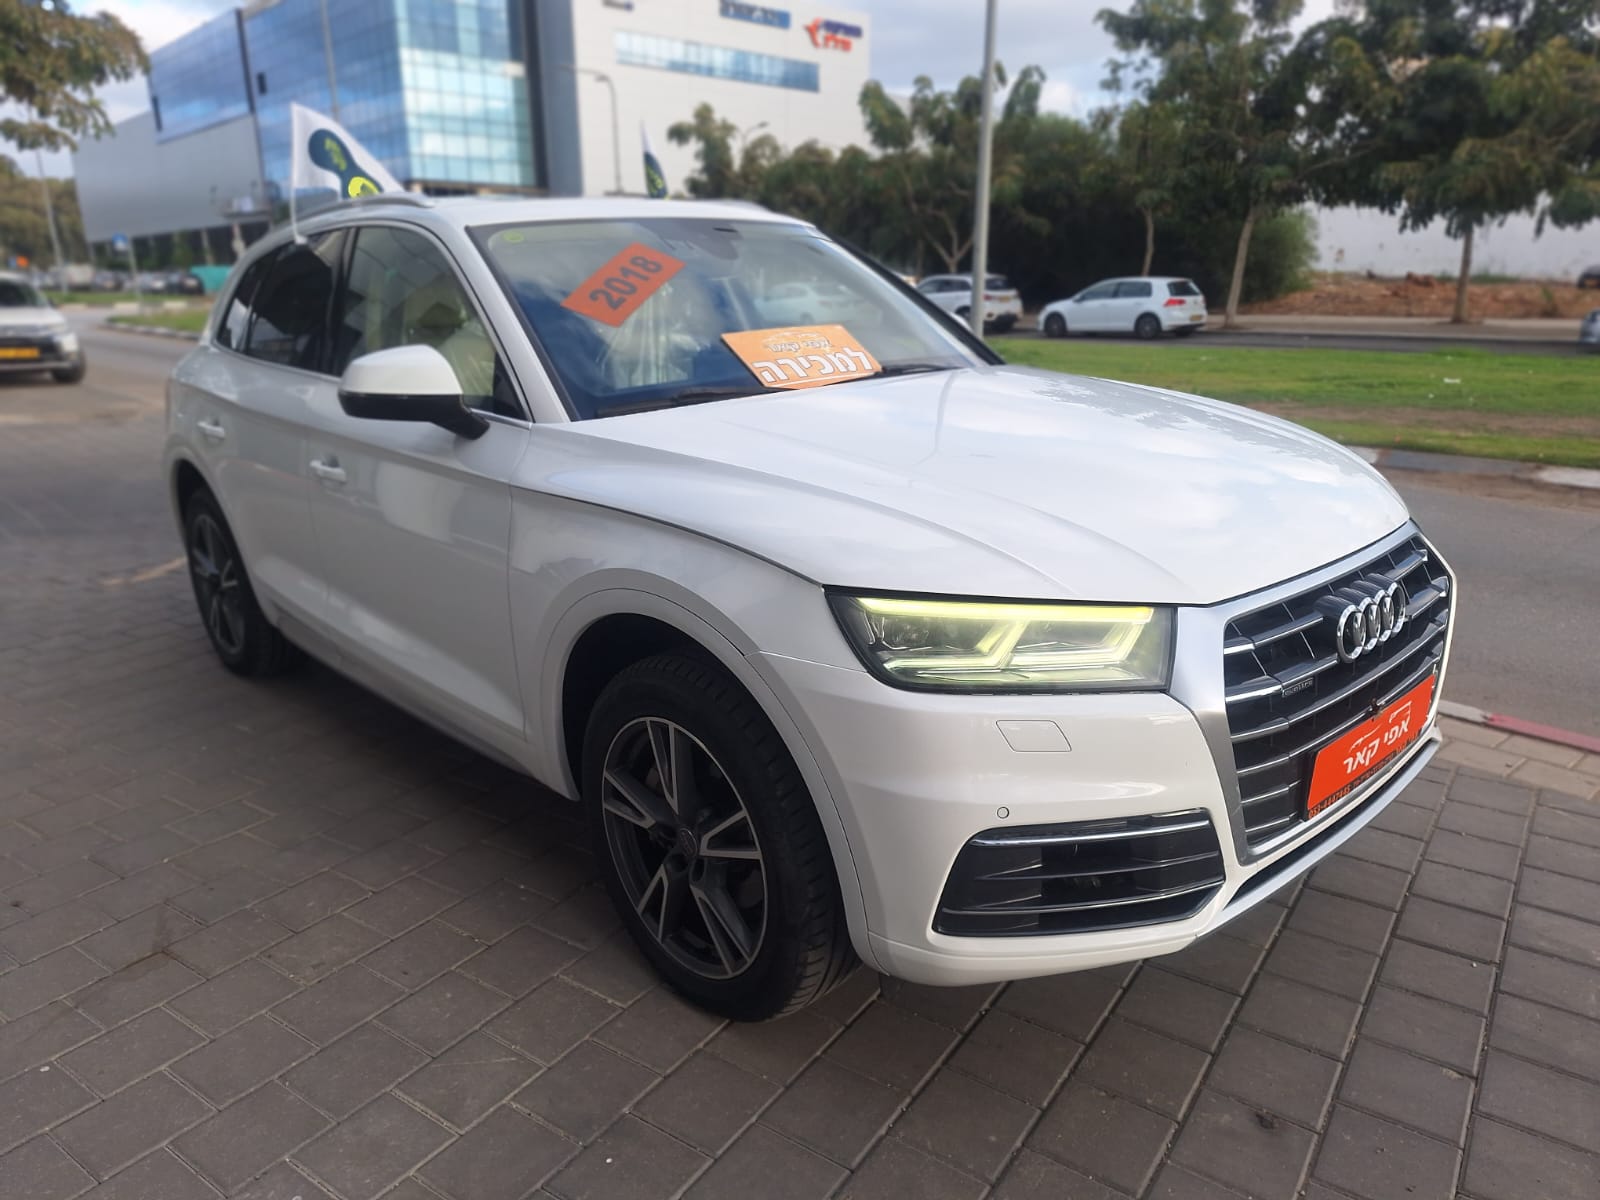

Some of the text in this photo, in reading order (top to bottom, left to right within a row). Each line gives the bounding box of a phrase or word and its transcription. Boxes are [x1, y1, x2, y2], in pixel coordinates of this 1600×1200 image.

[589, 255, 663, 311] 2018
[752, 347, 873, 383] למכירה
[1383, 717, 1411, 746] אפי
[1343, 738, 1380, 774] קאר
